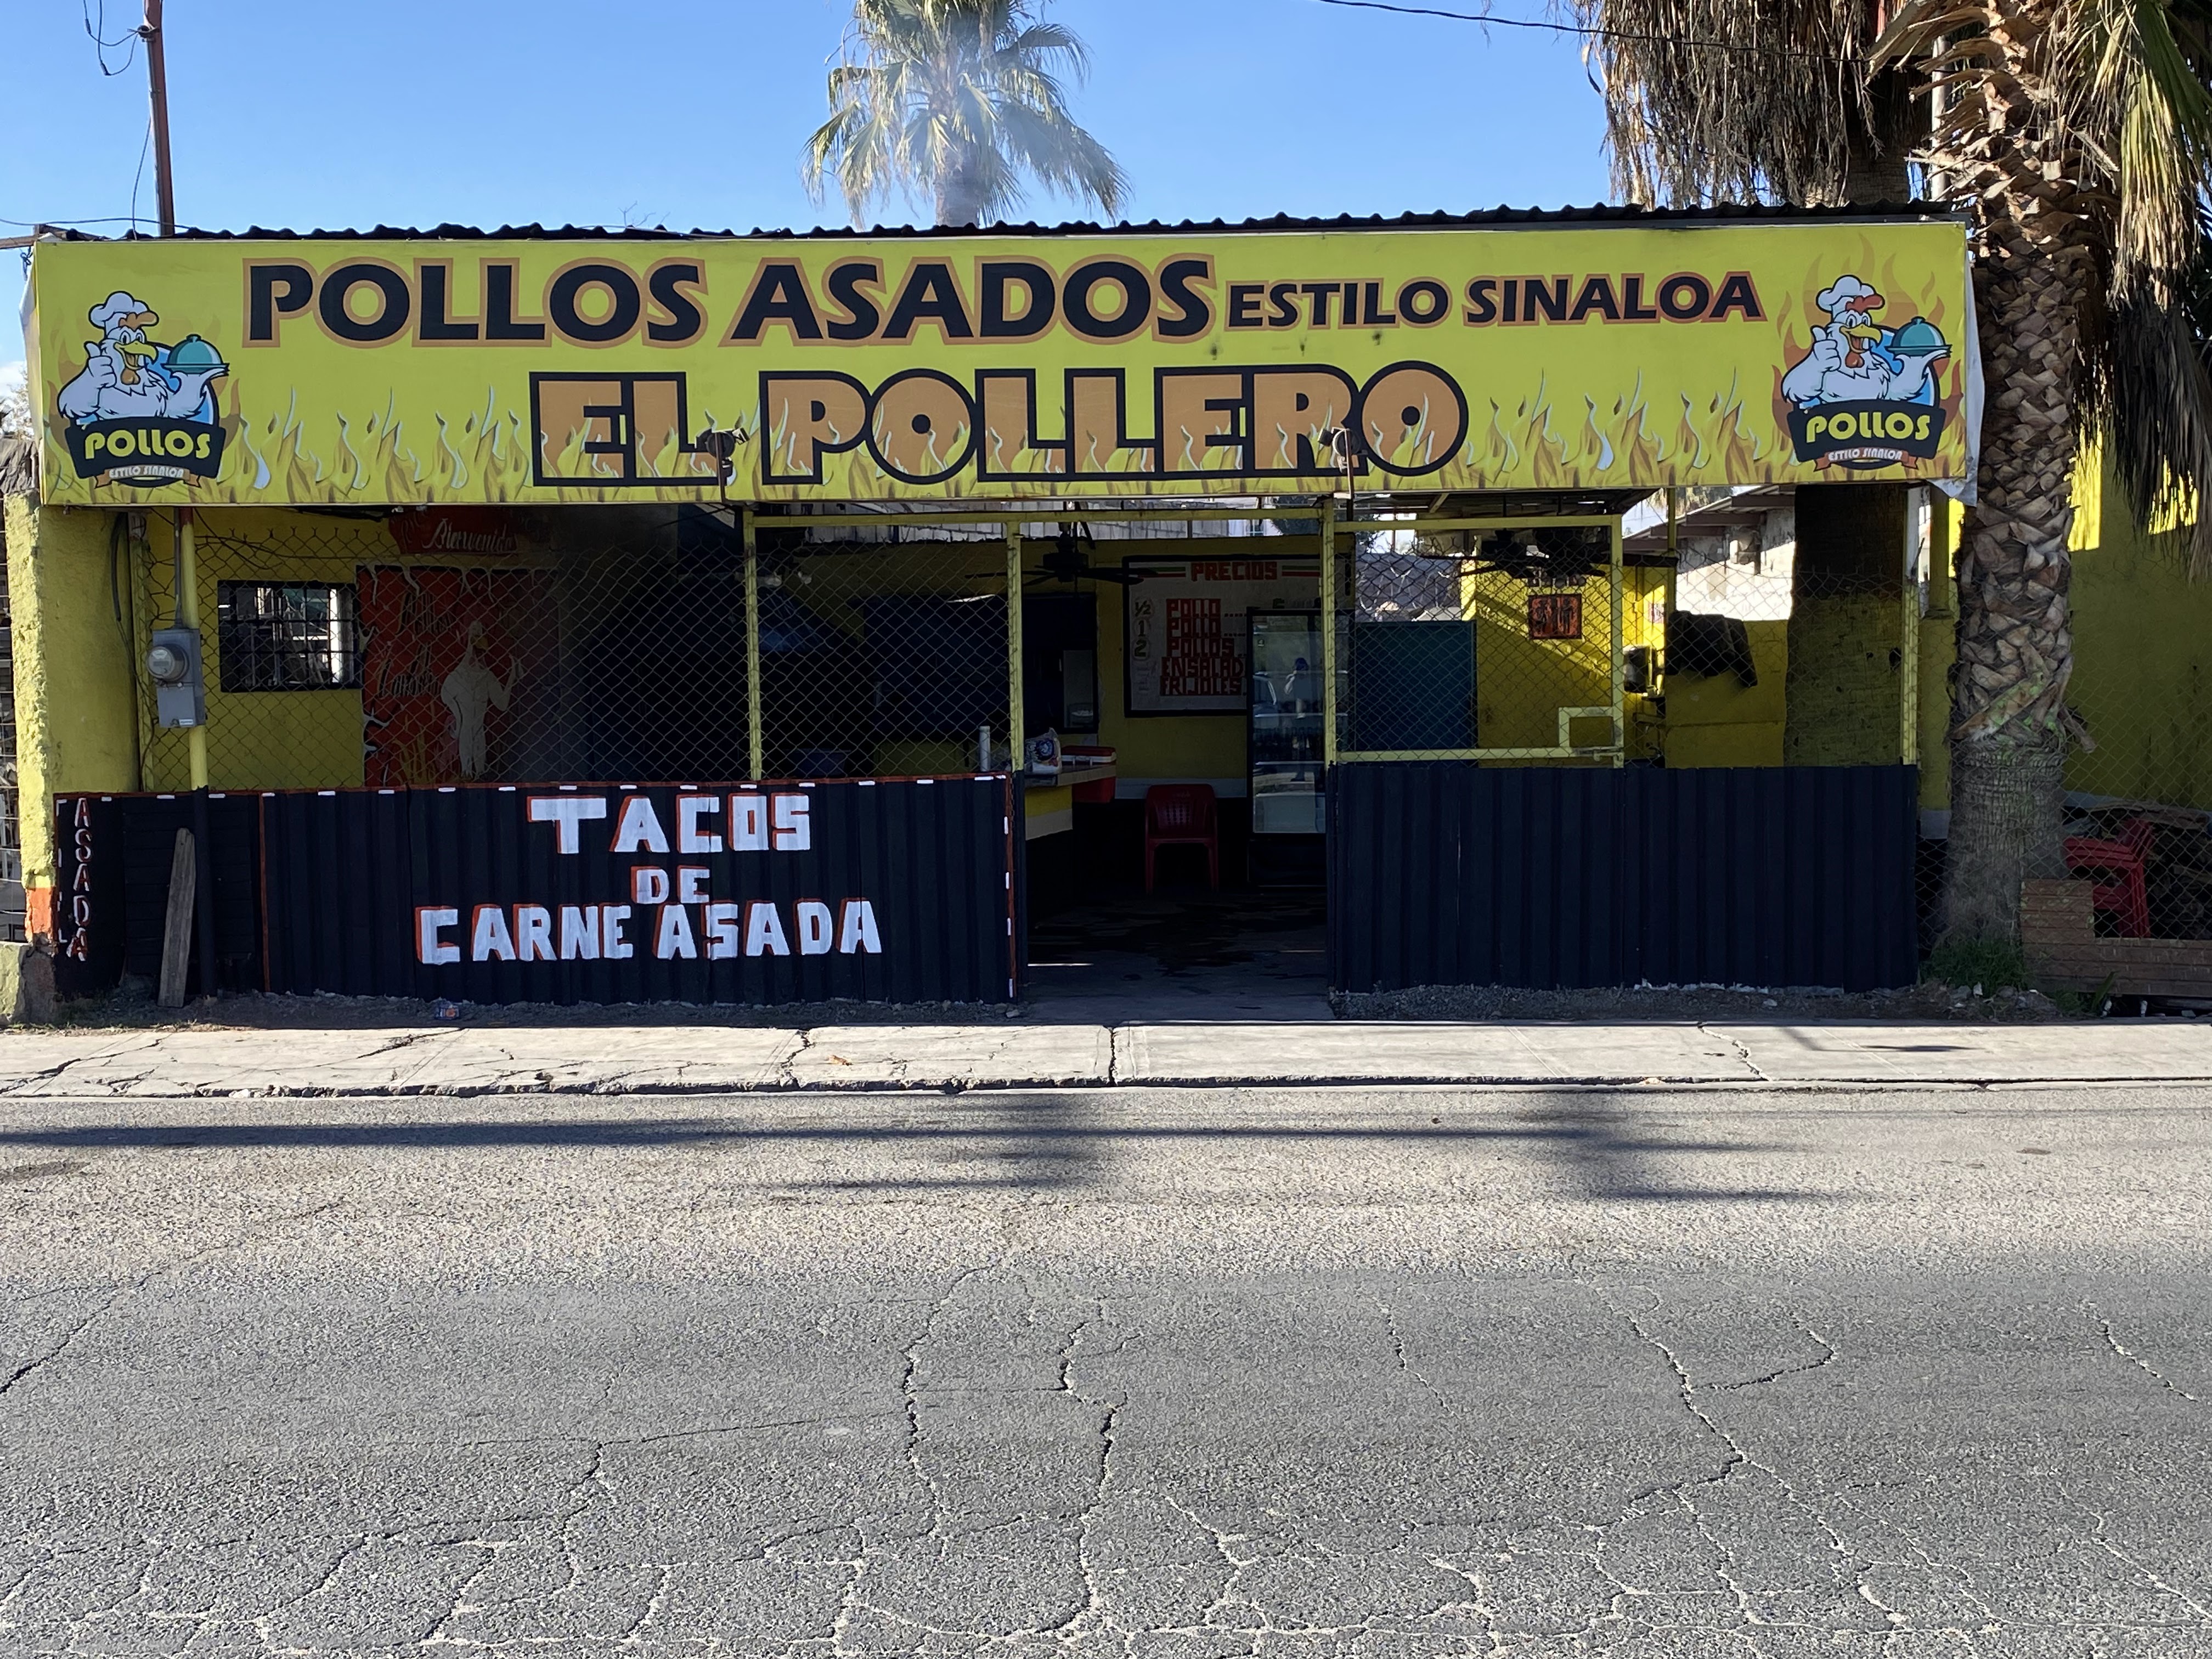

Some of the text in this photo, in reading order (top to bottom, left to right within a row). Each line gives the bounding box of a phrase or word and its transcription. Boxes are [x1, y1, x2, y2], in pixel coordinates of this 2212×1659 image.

[243, 254, 1767, 348] POLLOS ASADOS ESTILO SINALOA
[529, 360, 1469, 487] EL POLLERO
[1806, 412, 1931, 443] POLLOS
[84, 429, 211, 460] POLLOS
[1828, 448, 1860, 461] ESTILO
[109, 466, 142, 478] ESTILO
[1191, 562, 1278, 582] PRECIOS
[1166, 599, 1221, 618] POLLO
[1137, 618, 1221, 637] 1 POLLO
[1134, 637, 1234, 657] 2 POLLOS
[1161, 657, 1246, 677] ENSALAD
[1160, 676, 1242, 696] FRIJOLES
[527, 793, 811, 854] TACOS
[66, 797, 93, 962] ASADA
[631, 865, 710, 905] DE
[415, 897, 882, 966] CARNE ASADA
